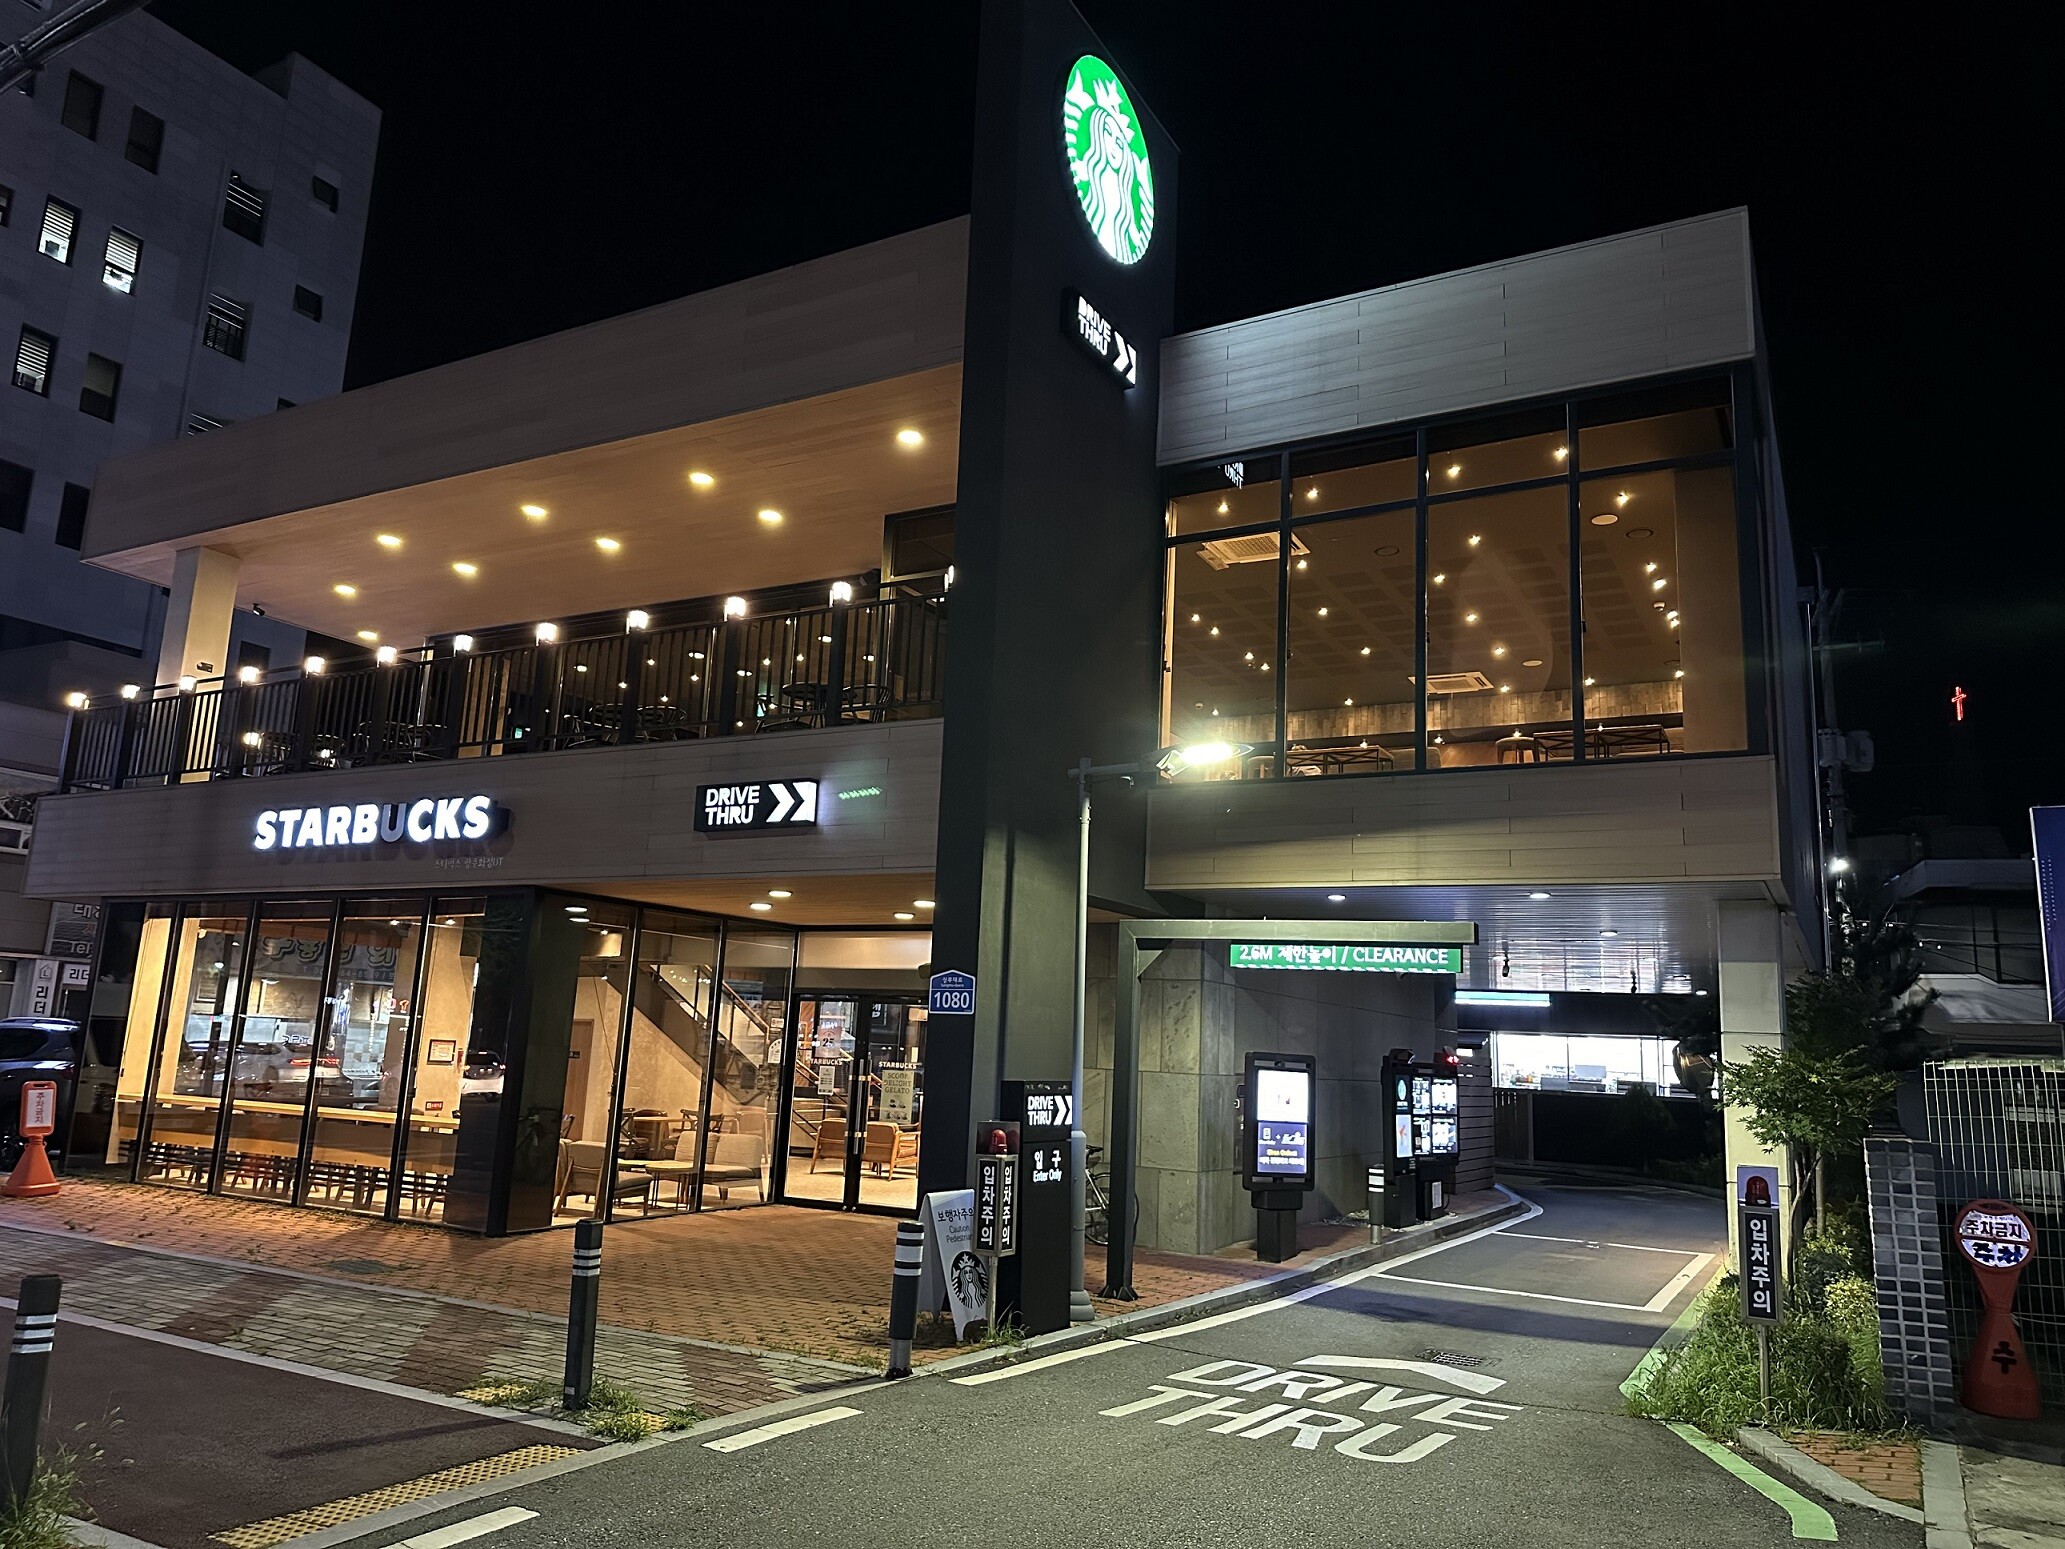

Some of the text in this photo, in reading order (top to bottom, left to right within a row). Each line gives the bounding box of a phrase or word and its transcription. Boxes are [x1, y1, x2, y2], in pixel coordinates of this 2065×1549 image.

[1078, 296, 1111, 342] DRIVE
[1078, 314, 1108, 355] THRU
[705, 785, 760, 806] DRIVE
[254, 795, 491, 850] STARBUCKS
[705, 804, 754, 825] THRU
[1239, 945, 1273, 961] 2.6M
[1352, 946, 1449, 964] CLEARANCE
[34, 985, 49, 1014] 리더
[934, 991, 969, 1008] 1080
[878, 1061, 917, 1070] STARBUCKS
[885, 1086, 910, 1094] GELATO
[34, 1091, 46, 1124] 주차금지
[1027, 1095, 1054, 1110] DRIVE
[1027, 1110, 1052, 1126] THRU
[1033, 1168, 1063, 1182] Enter Only
[980, 1166, 995, 1246] 입차주의
[1001, 1166, 1013, 1246] 입차주의
[949, 1225, 970, 1234] Caution
[1966, 1219, 2022, 1239] 주차금지
[1750, 1219, 1771, 1313] 입차주의
[1166, 1359, 1524, 1431] DRIVE
[1098, 1385, 1457, 1463] THRU
